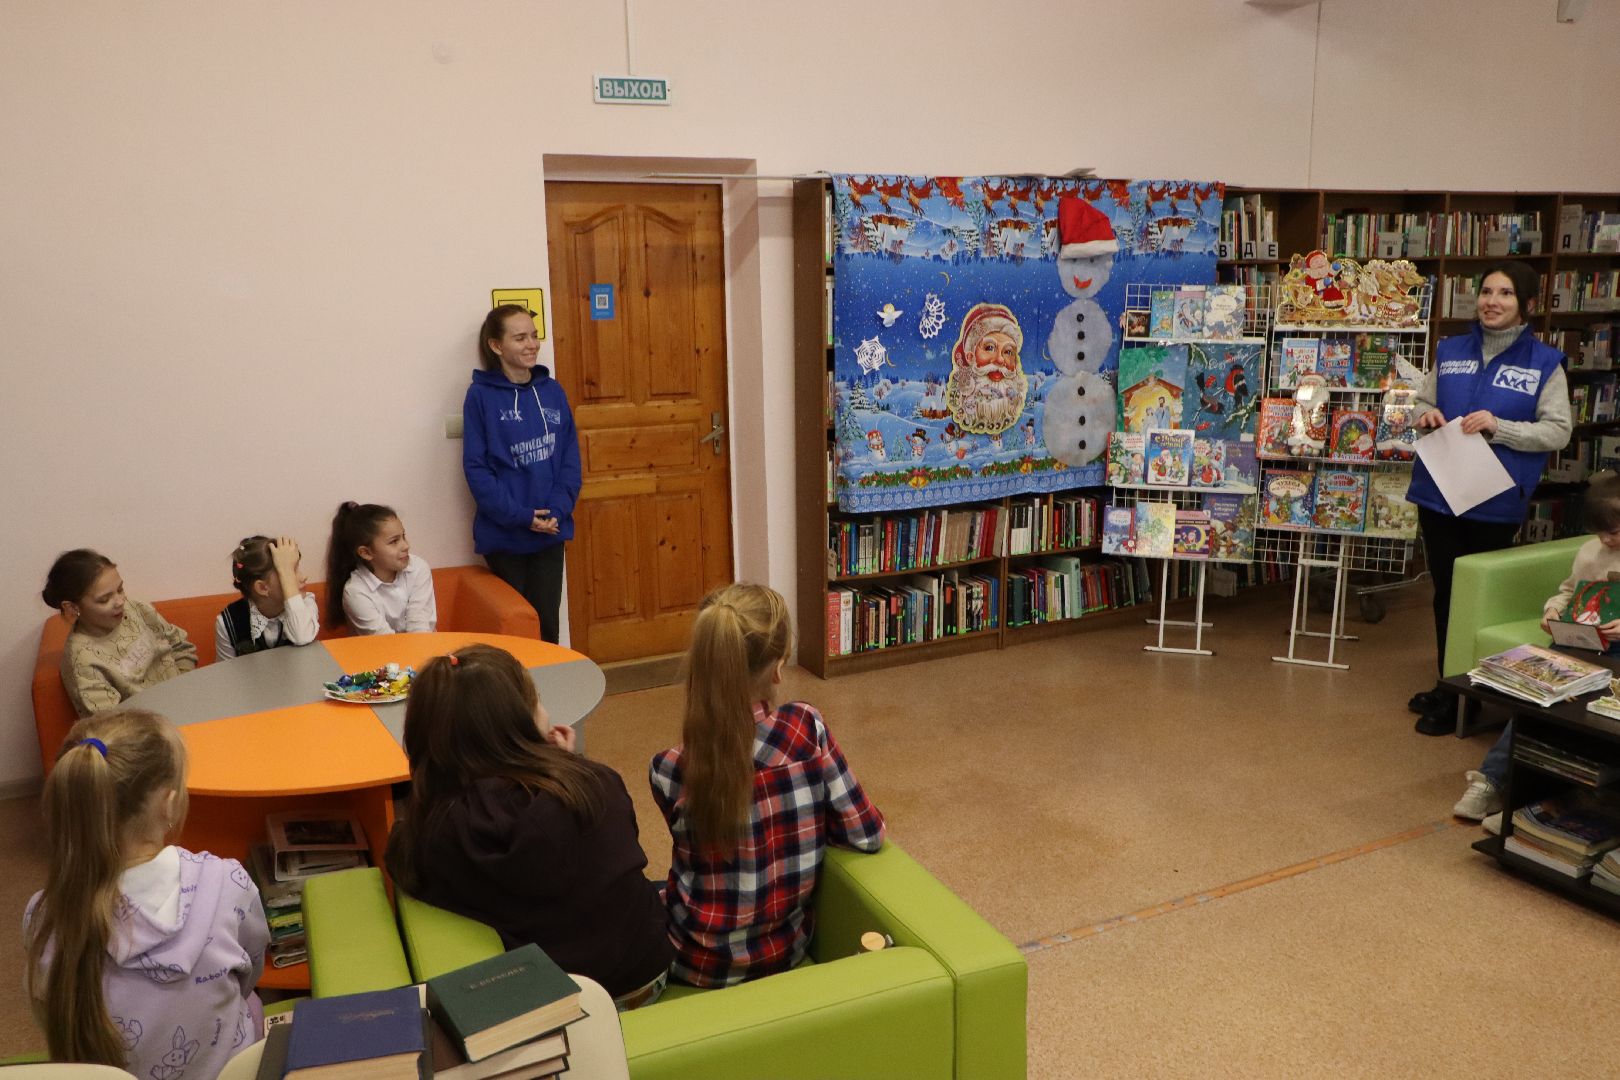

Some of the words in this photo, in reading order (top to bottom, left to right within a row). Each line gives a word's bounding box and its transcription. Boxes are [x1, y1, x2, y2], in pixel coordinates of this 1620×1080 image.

[602, 80, 664, 98] ВЫХОД
[1219, 244, 1228, 258] В
[1243, 242, 1254, 258] Д
[1268, 244, 1276, 257] Е
